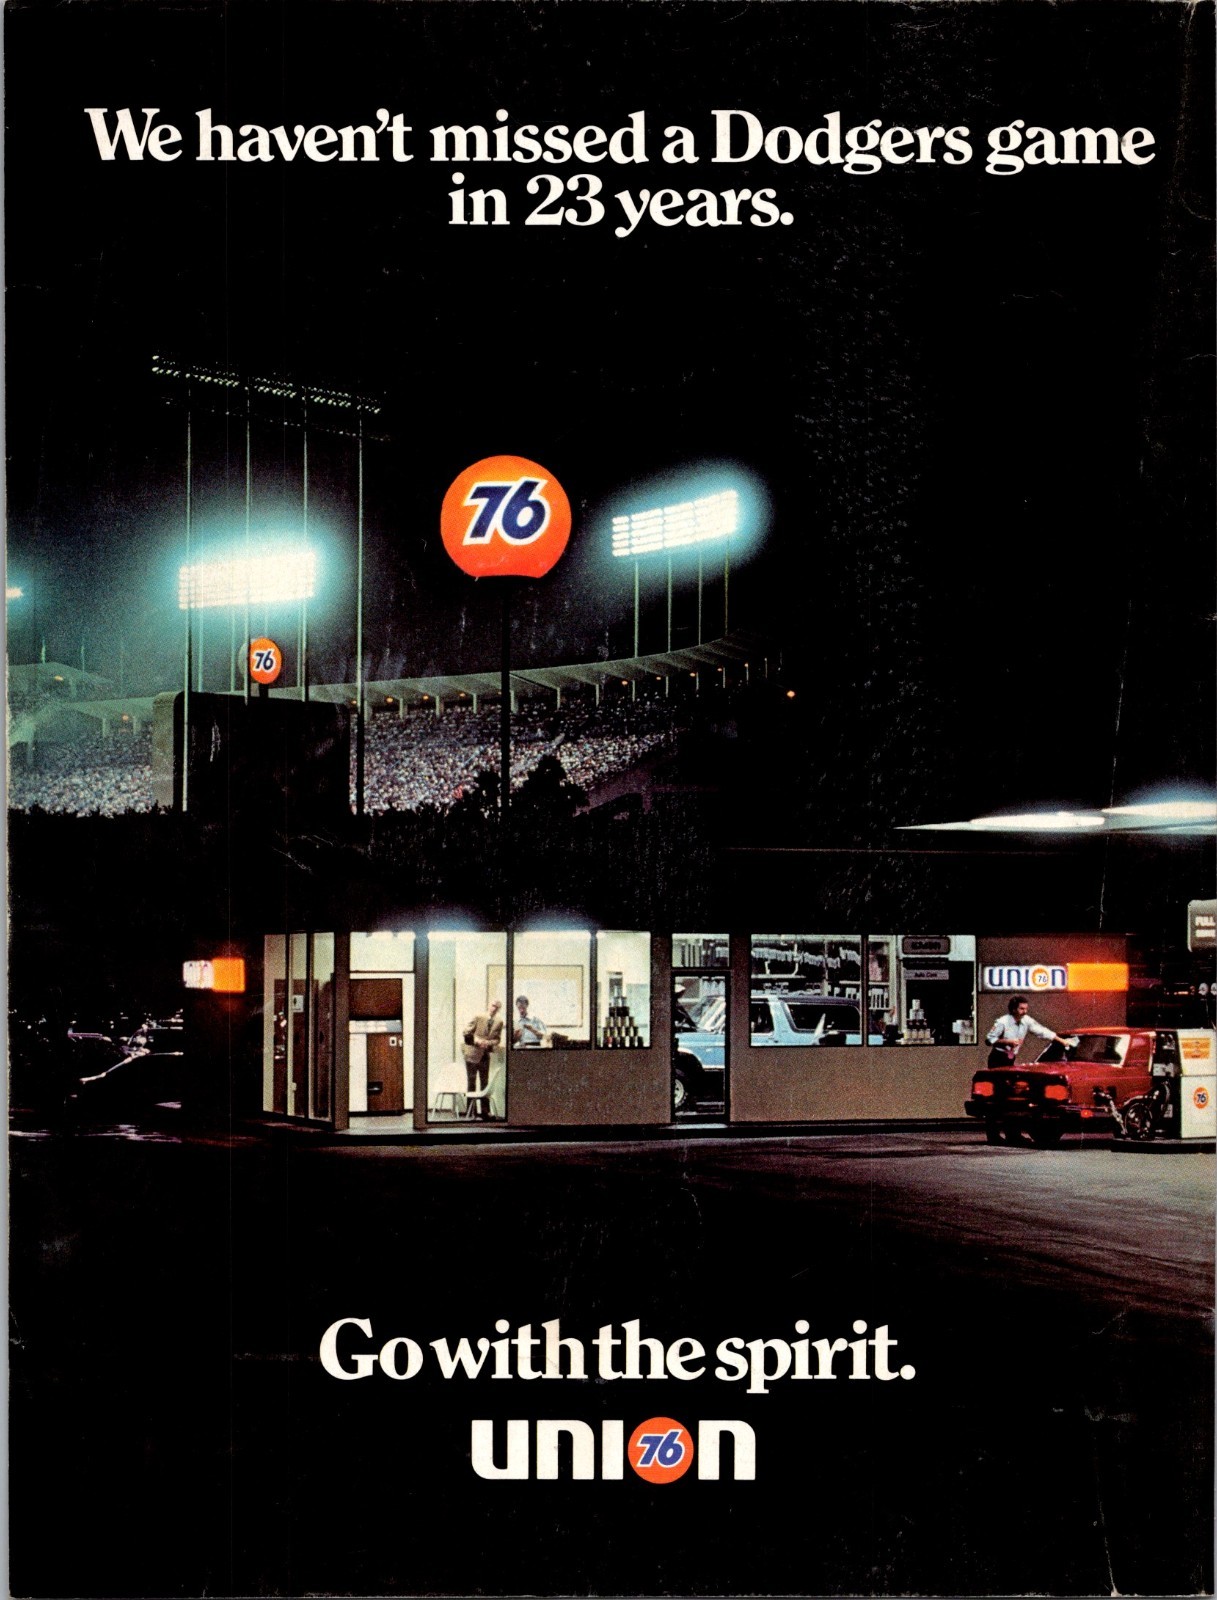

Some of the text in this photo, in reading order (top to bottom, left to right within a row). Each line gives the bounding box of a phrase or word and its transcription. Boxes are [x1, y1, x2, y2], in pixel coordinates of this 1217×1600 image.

[84, 108, 1155, 175] We haven't missed a Dodgers game
[449, 172, 793, 237] in 23 years.
[463, 477, 550, 545] 76
[254, 649, 275, 671] 76
[1197, 1092, 1206, 1103] 76
[320, 1318, 915, 1393] Go with the spirit.
[636, 1429, 685, 1467] 76
